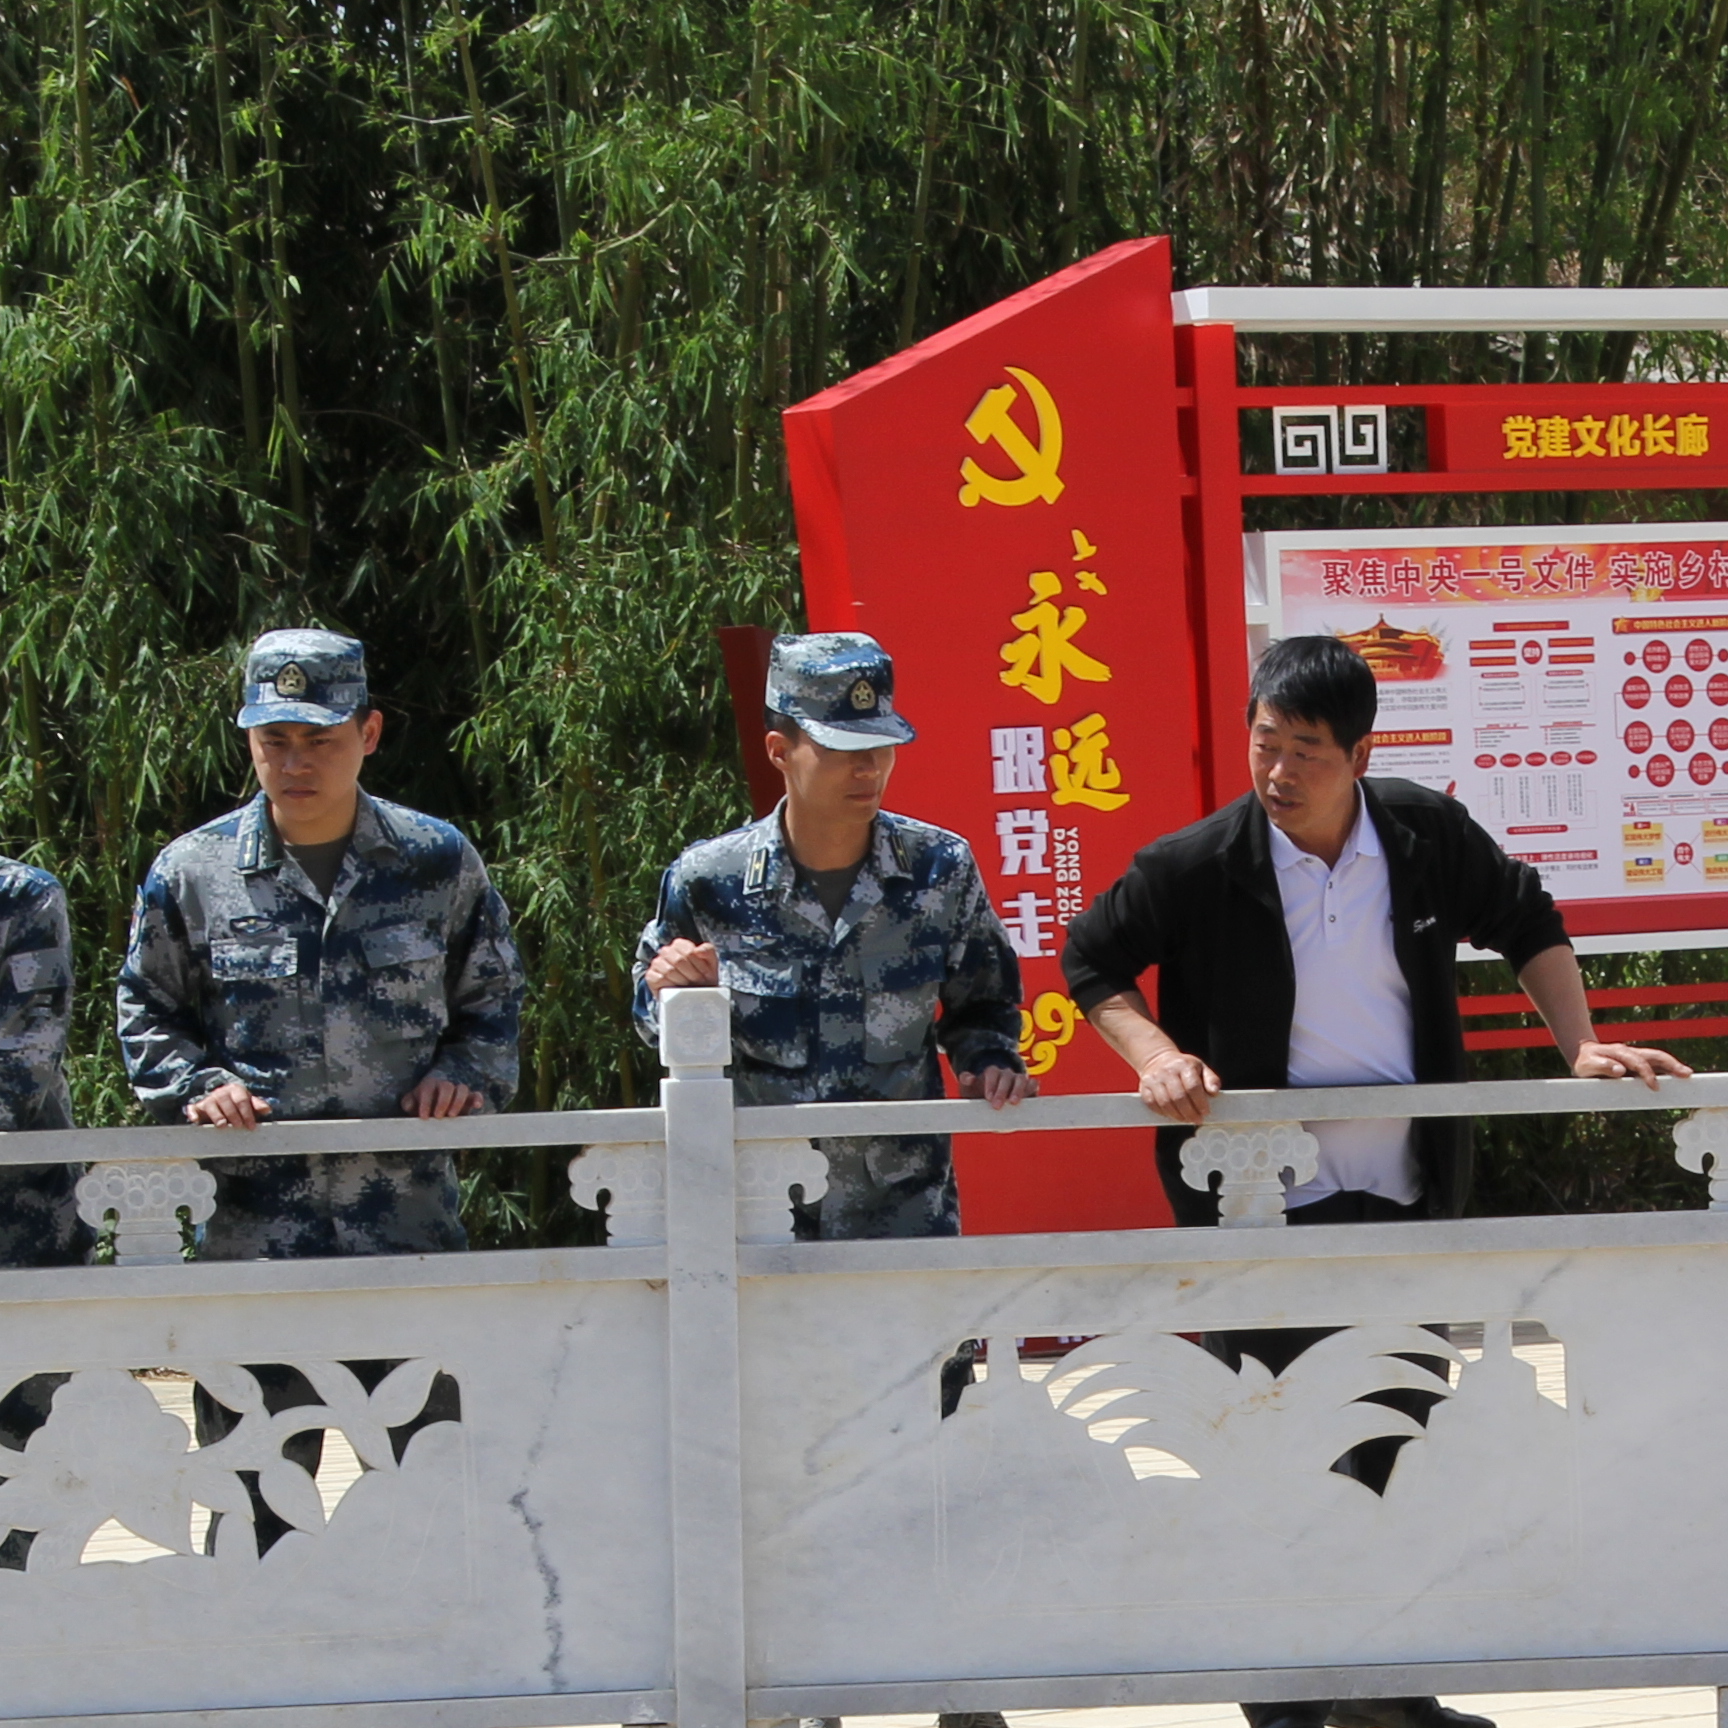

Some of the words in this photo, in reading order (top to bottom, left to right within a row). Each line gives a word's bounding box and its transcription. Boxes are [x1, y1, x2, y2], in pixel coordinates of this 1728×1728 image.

[1501, 413, 1710, 460] 党建文化长廊
[1321, 554, 1595, 597] 聚焦中央一号文件
[999, 570, 1130, 812] 永远
[990, 726, 1057, 958] 跟党走
[1052, 828, 1069, 883] DANG
[1066, 826, 1082, 882] YONG
[1055, 886, 1070, 926] ZOU
[1070, 885, 1084, 917] YU
